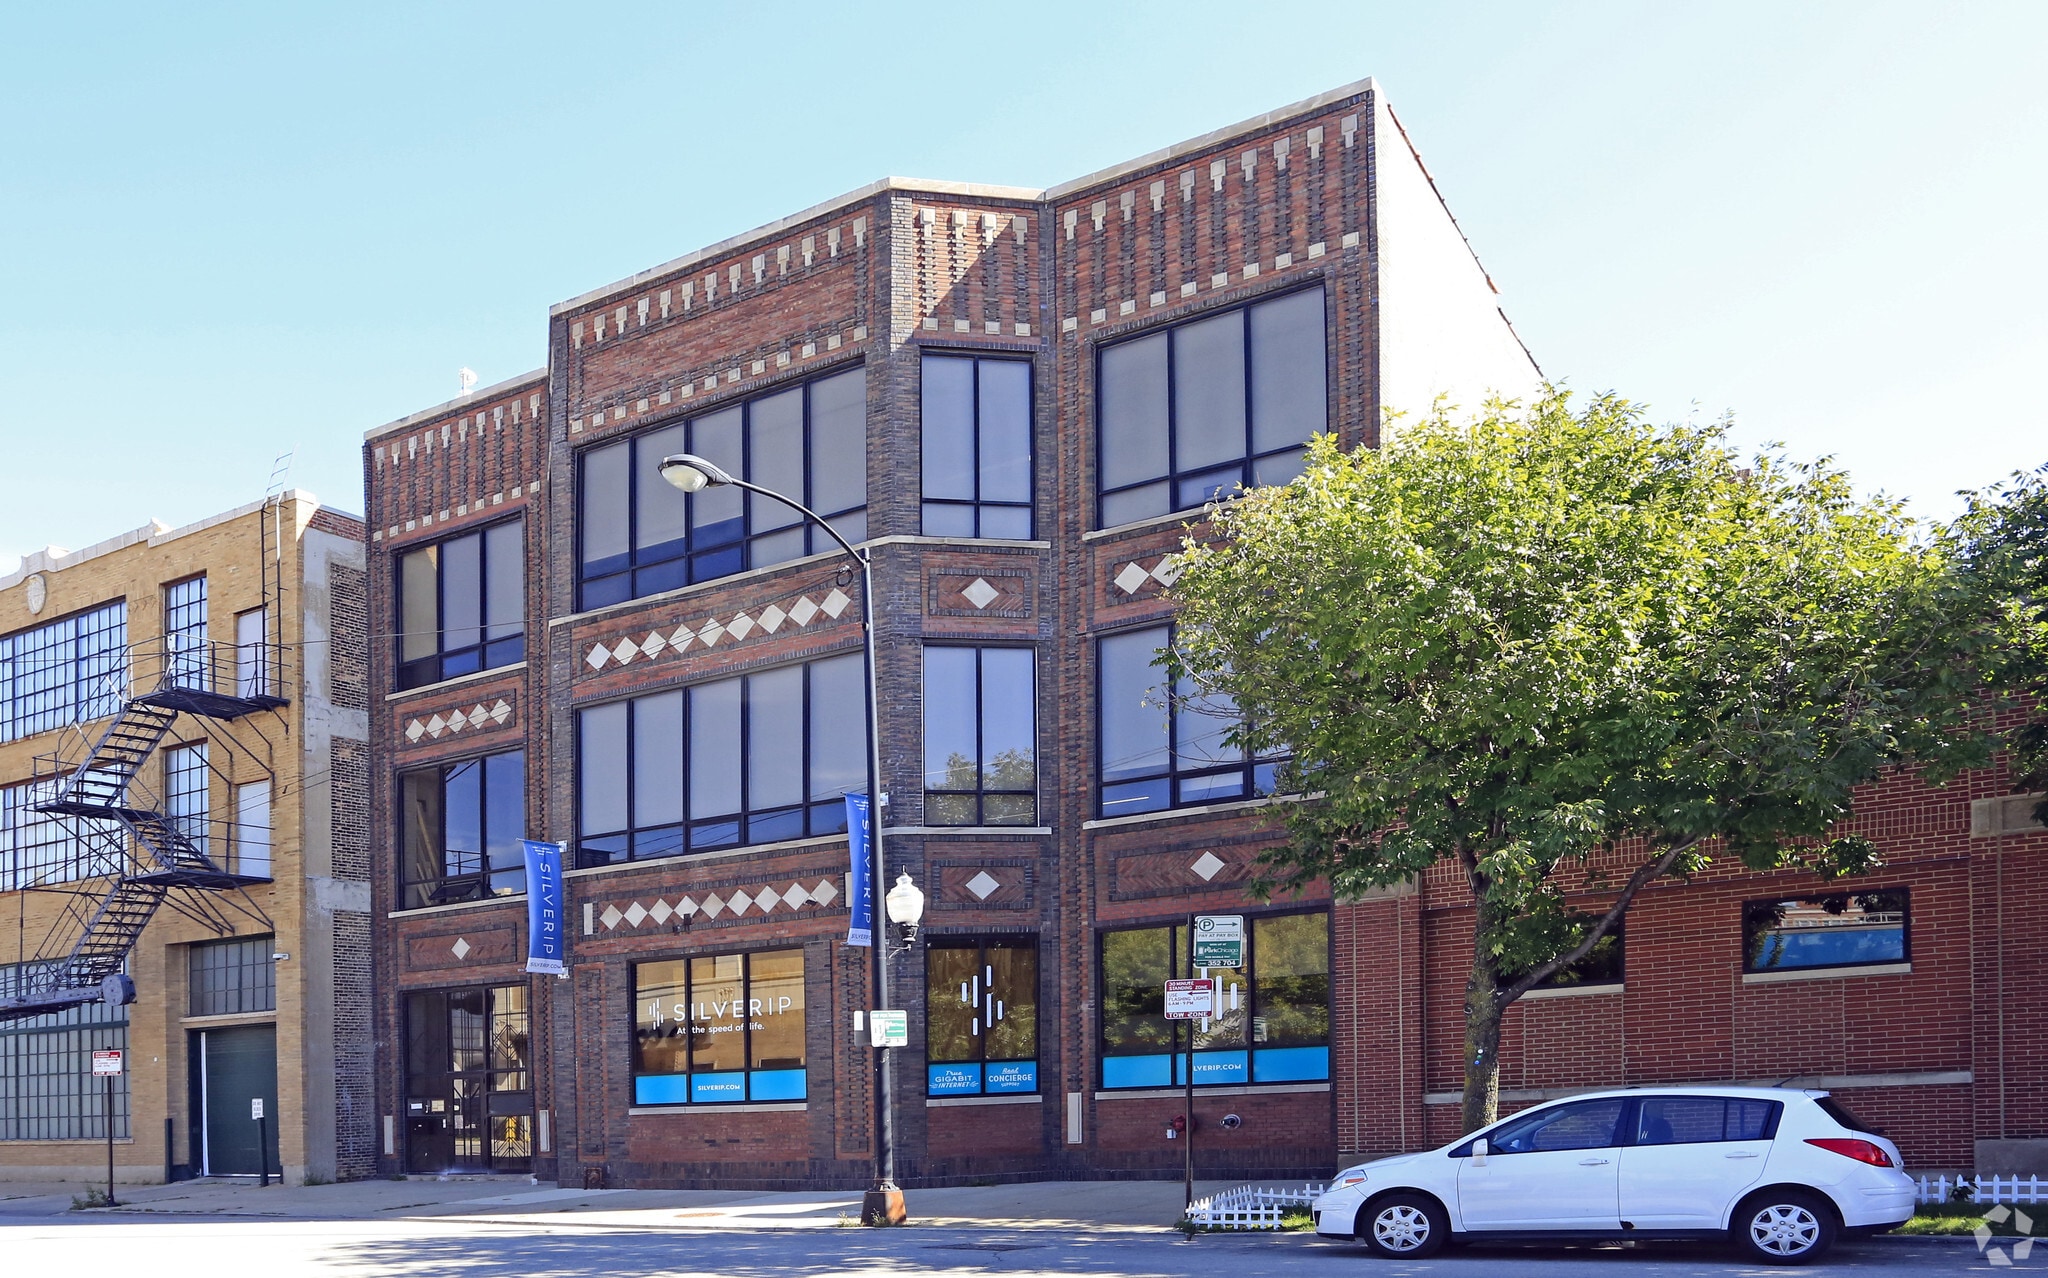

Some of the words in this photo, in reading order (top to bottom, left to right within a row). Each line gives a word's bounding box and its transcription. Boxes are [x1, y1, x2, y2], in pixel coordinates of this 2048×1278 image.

[540, 862, 554, 954] SILVERIP
[673, 997, 791, 1021] SILVERIP
[677, 1027, 686, 1035] At
[692, 1026, 705, 1034] the
[709, 1024, 733, 1035] speed
[735, 1023, 744, 1032] of
[750, 1021, 765, 1031] life.
[1002, 1067, 1019, 1075] Real
[1193, 1063, 1242, 1072] LVERIP.COM
[935, 1075, 973, 1083] GIGABIT
[988, 1073, 1032, 1083] CONCIERGE
[938, 1081, 970, 1089] INTERNET
